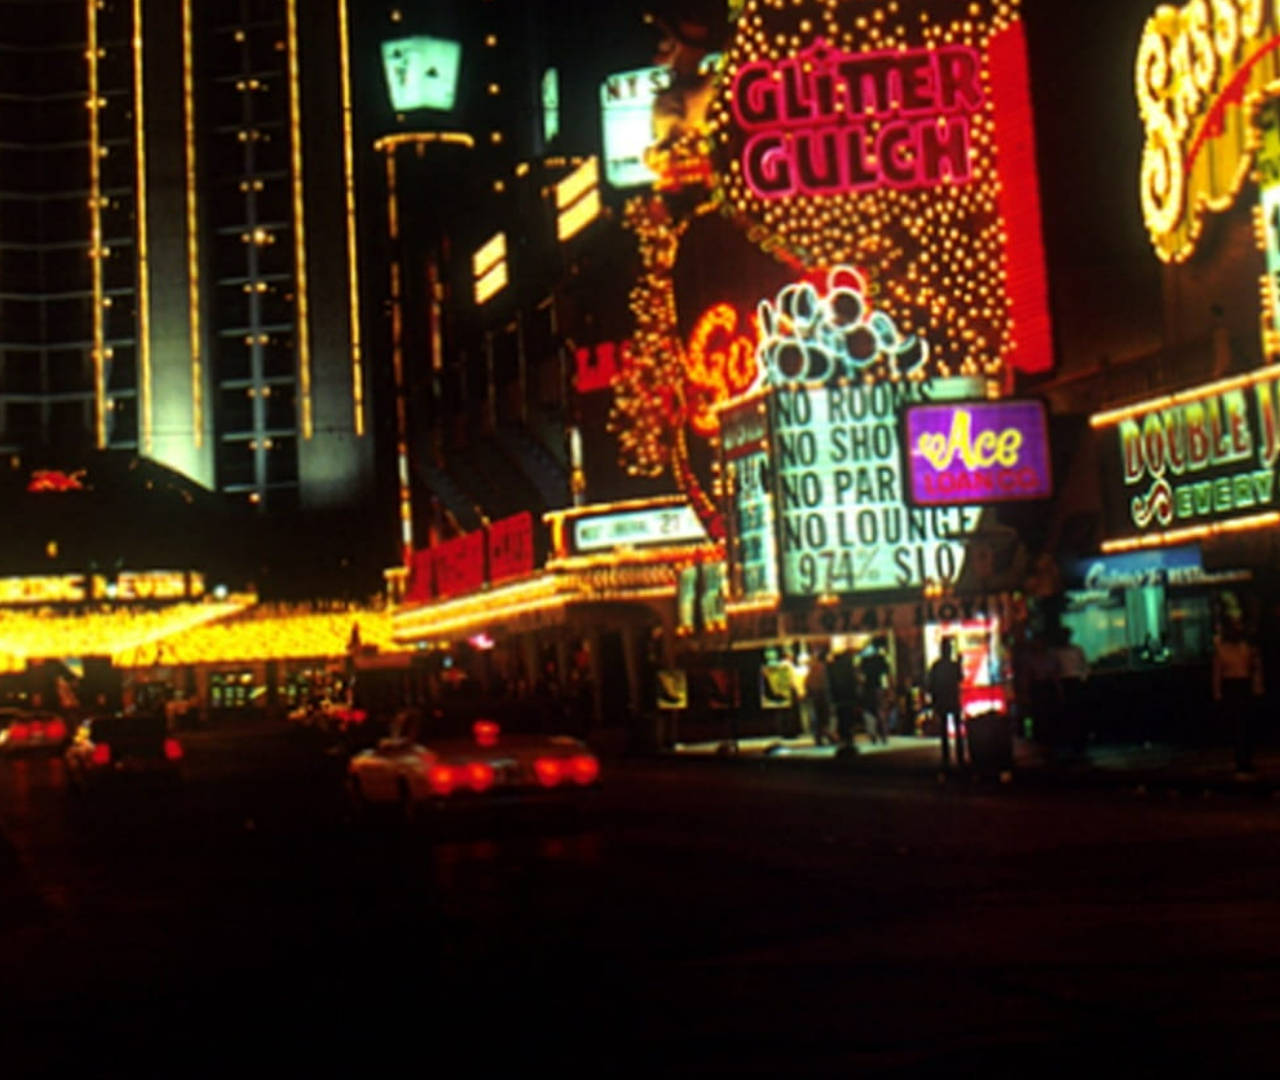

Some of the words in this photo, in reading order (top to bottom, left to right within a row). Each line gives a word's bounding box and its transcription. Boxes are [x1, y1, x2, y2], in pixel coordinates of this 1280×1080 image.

[732, 37, 984, 126] GLITTER
[743, 116, 971, 199] GULCH
[775, 385, 812, 428] NO
[778, 431, 817, 468] NO
[917, 408, 1023, 471] Ace
[1120, 385, 1252, 485] DOUBLE
[780, 472, 823, 510] NO
[1173, 468, 1275, 518] EVERY
[783, 513, 829, 552] NO
